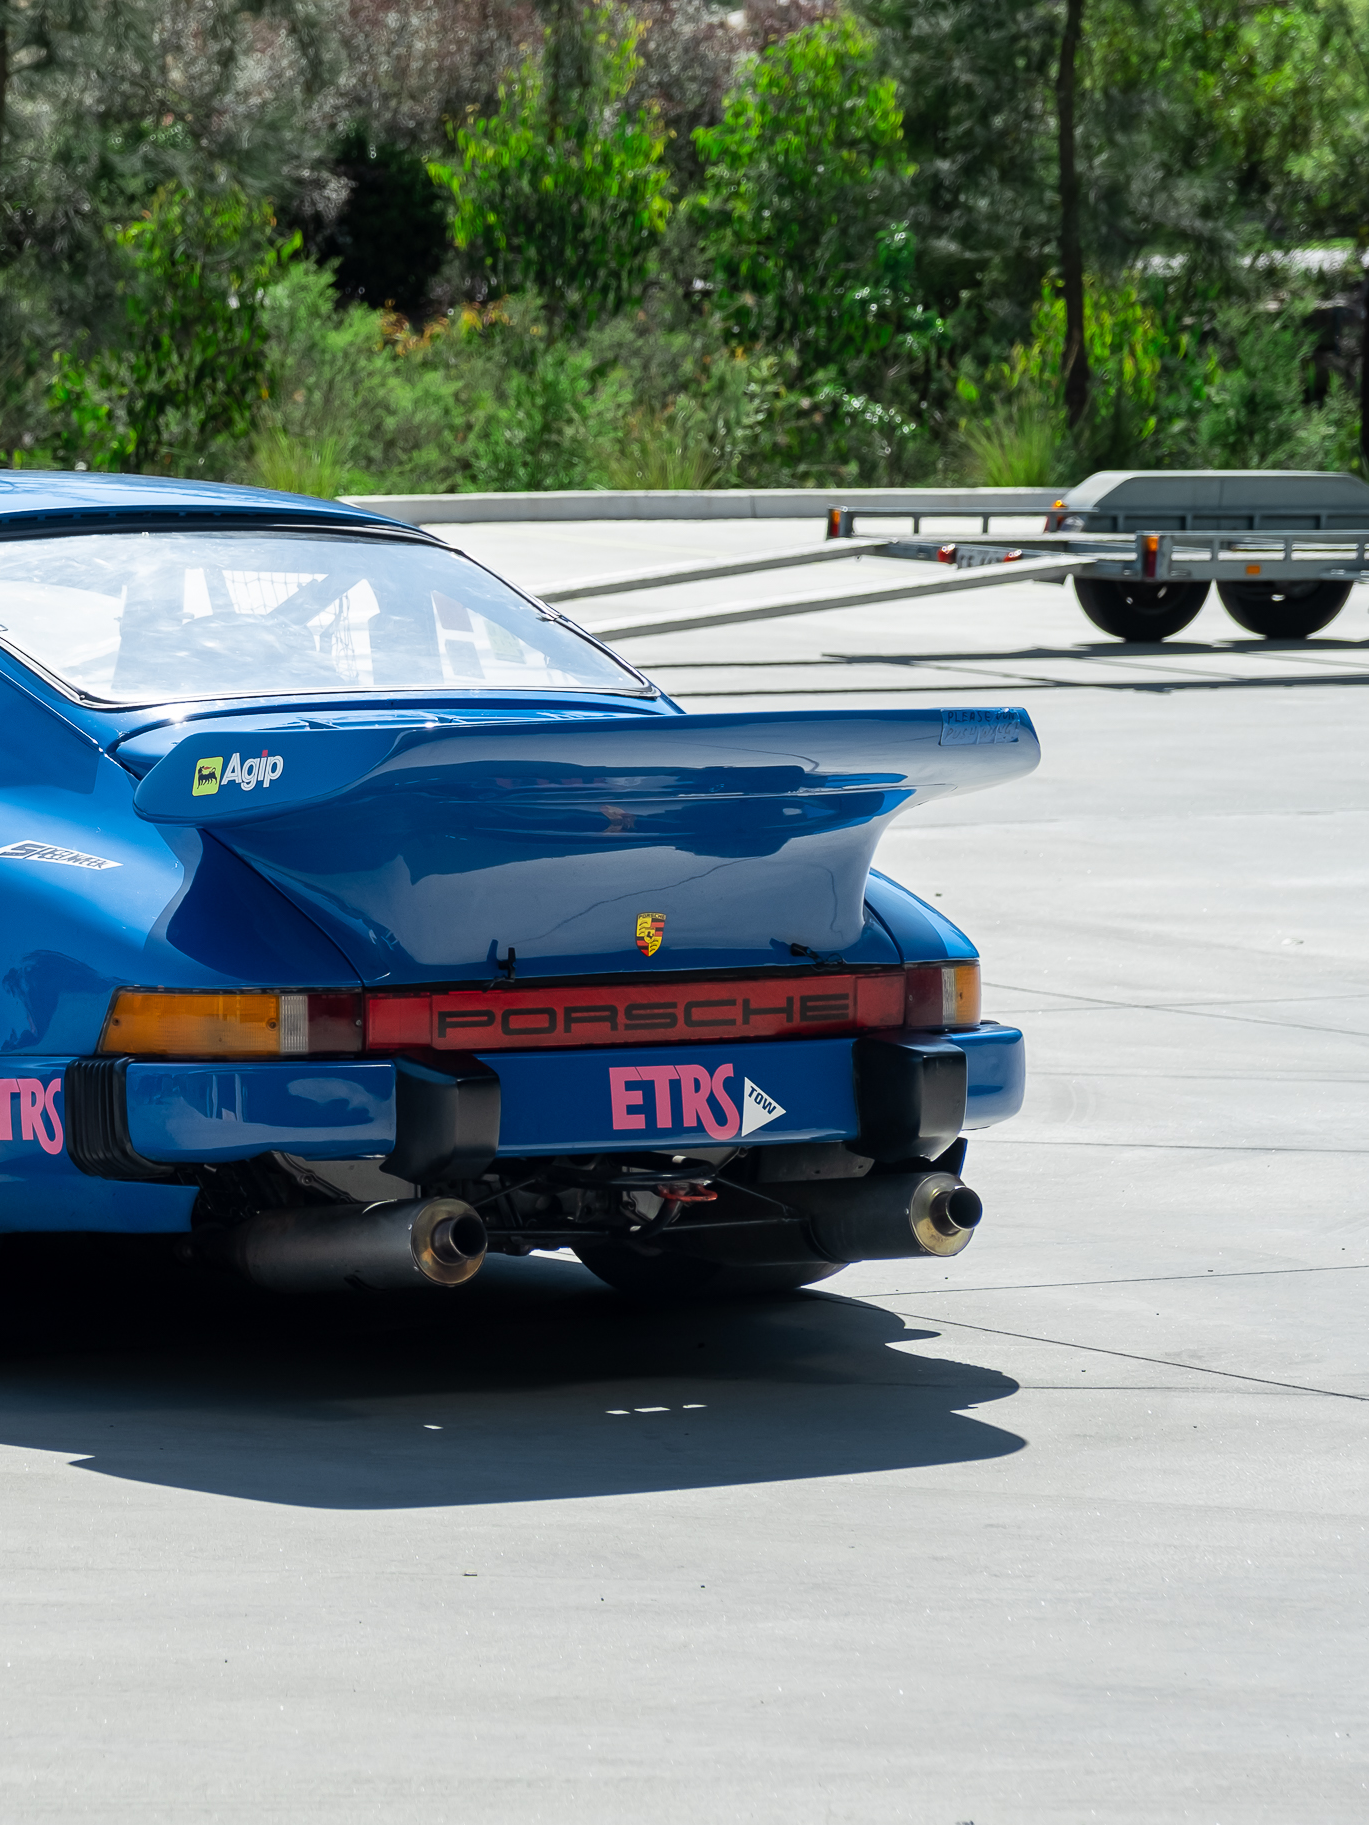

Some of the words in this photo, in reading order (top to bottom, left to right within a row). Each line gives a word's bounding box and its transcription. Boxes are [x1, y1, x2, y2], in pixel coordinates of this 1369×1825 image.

[947, 711, 991, 725] PLEASE
[221, 750, 284, 791] Agip
[438, 993, 849, 1038] PORSCHE
[609, 1063, 741, 1140] ETRS
[748, 1086, 777, 1115] TOW
